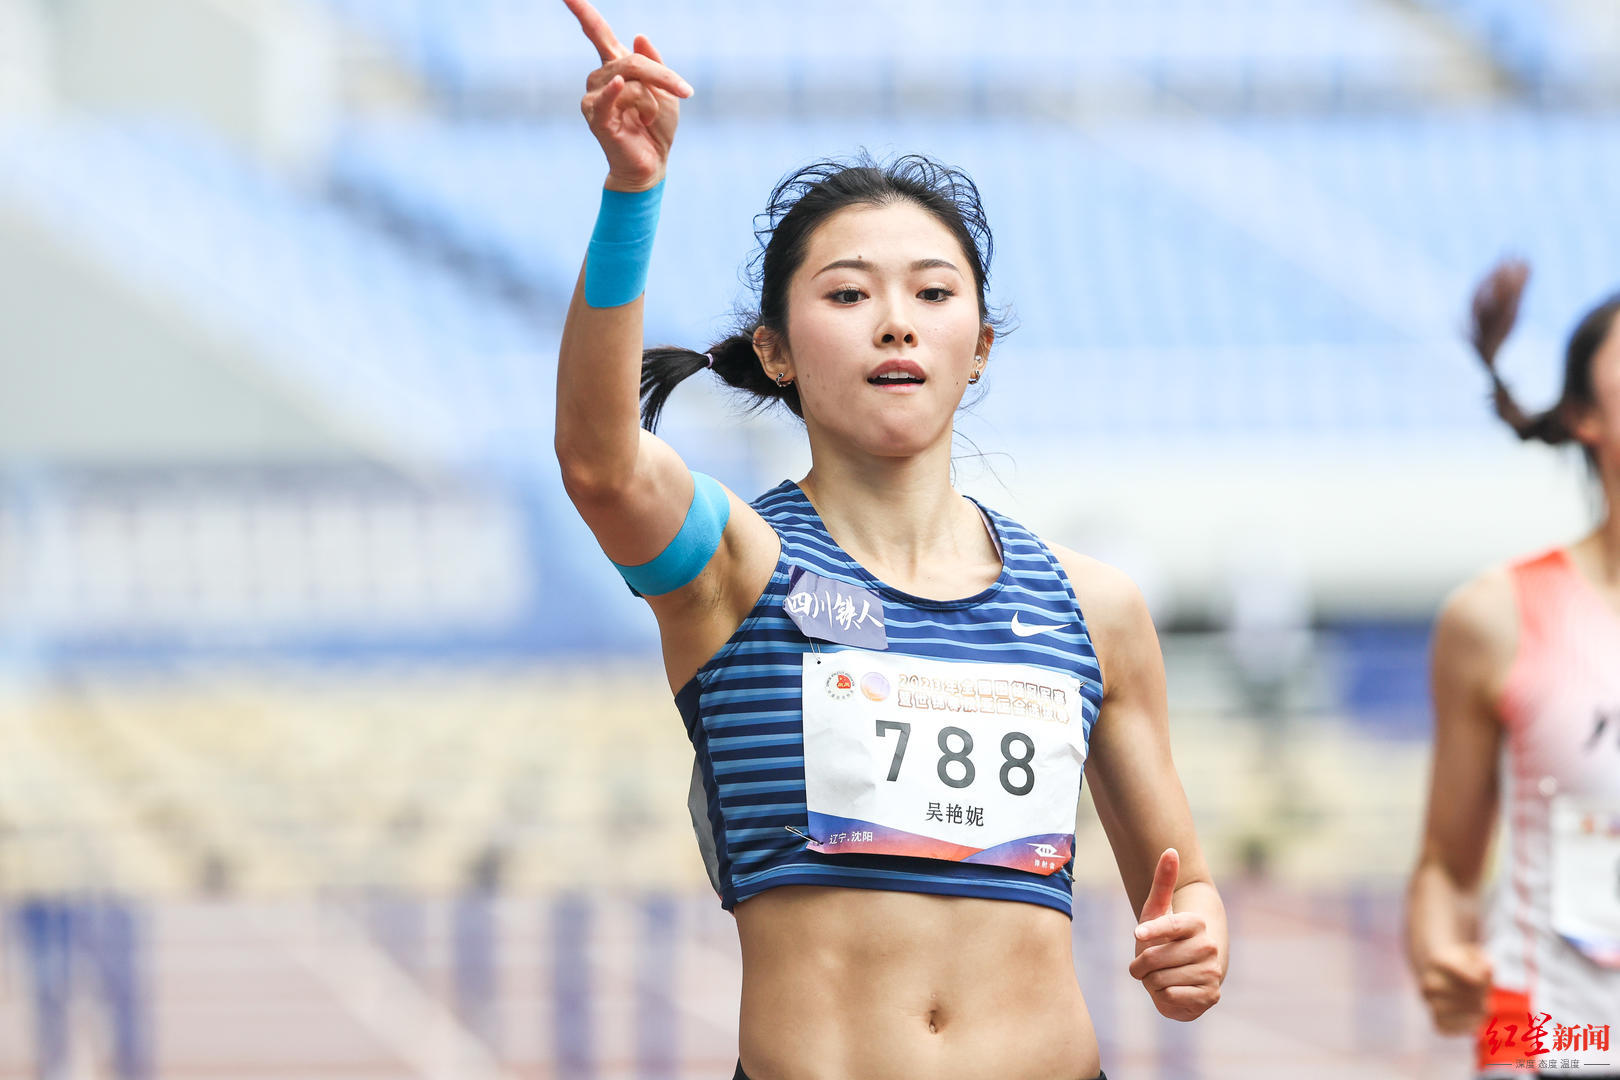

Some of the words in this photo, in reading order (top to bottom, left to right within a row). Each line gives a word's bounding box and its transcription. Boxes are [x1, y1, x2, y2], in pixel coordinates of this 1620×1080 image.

[875, 719, 1036, 796] 788
[925, 801, 984, 827] 吴艳妮
